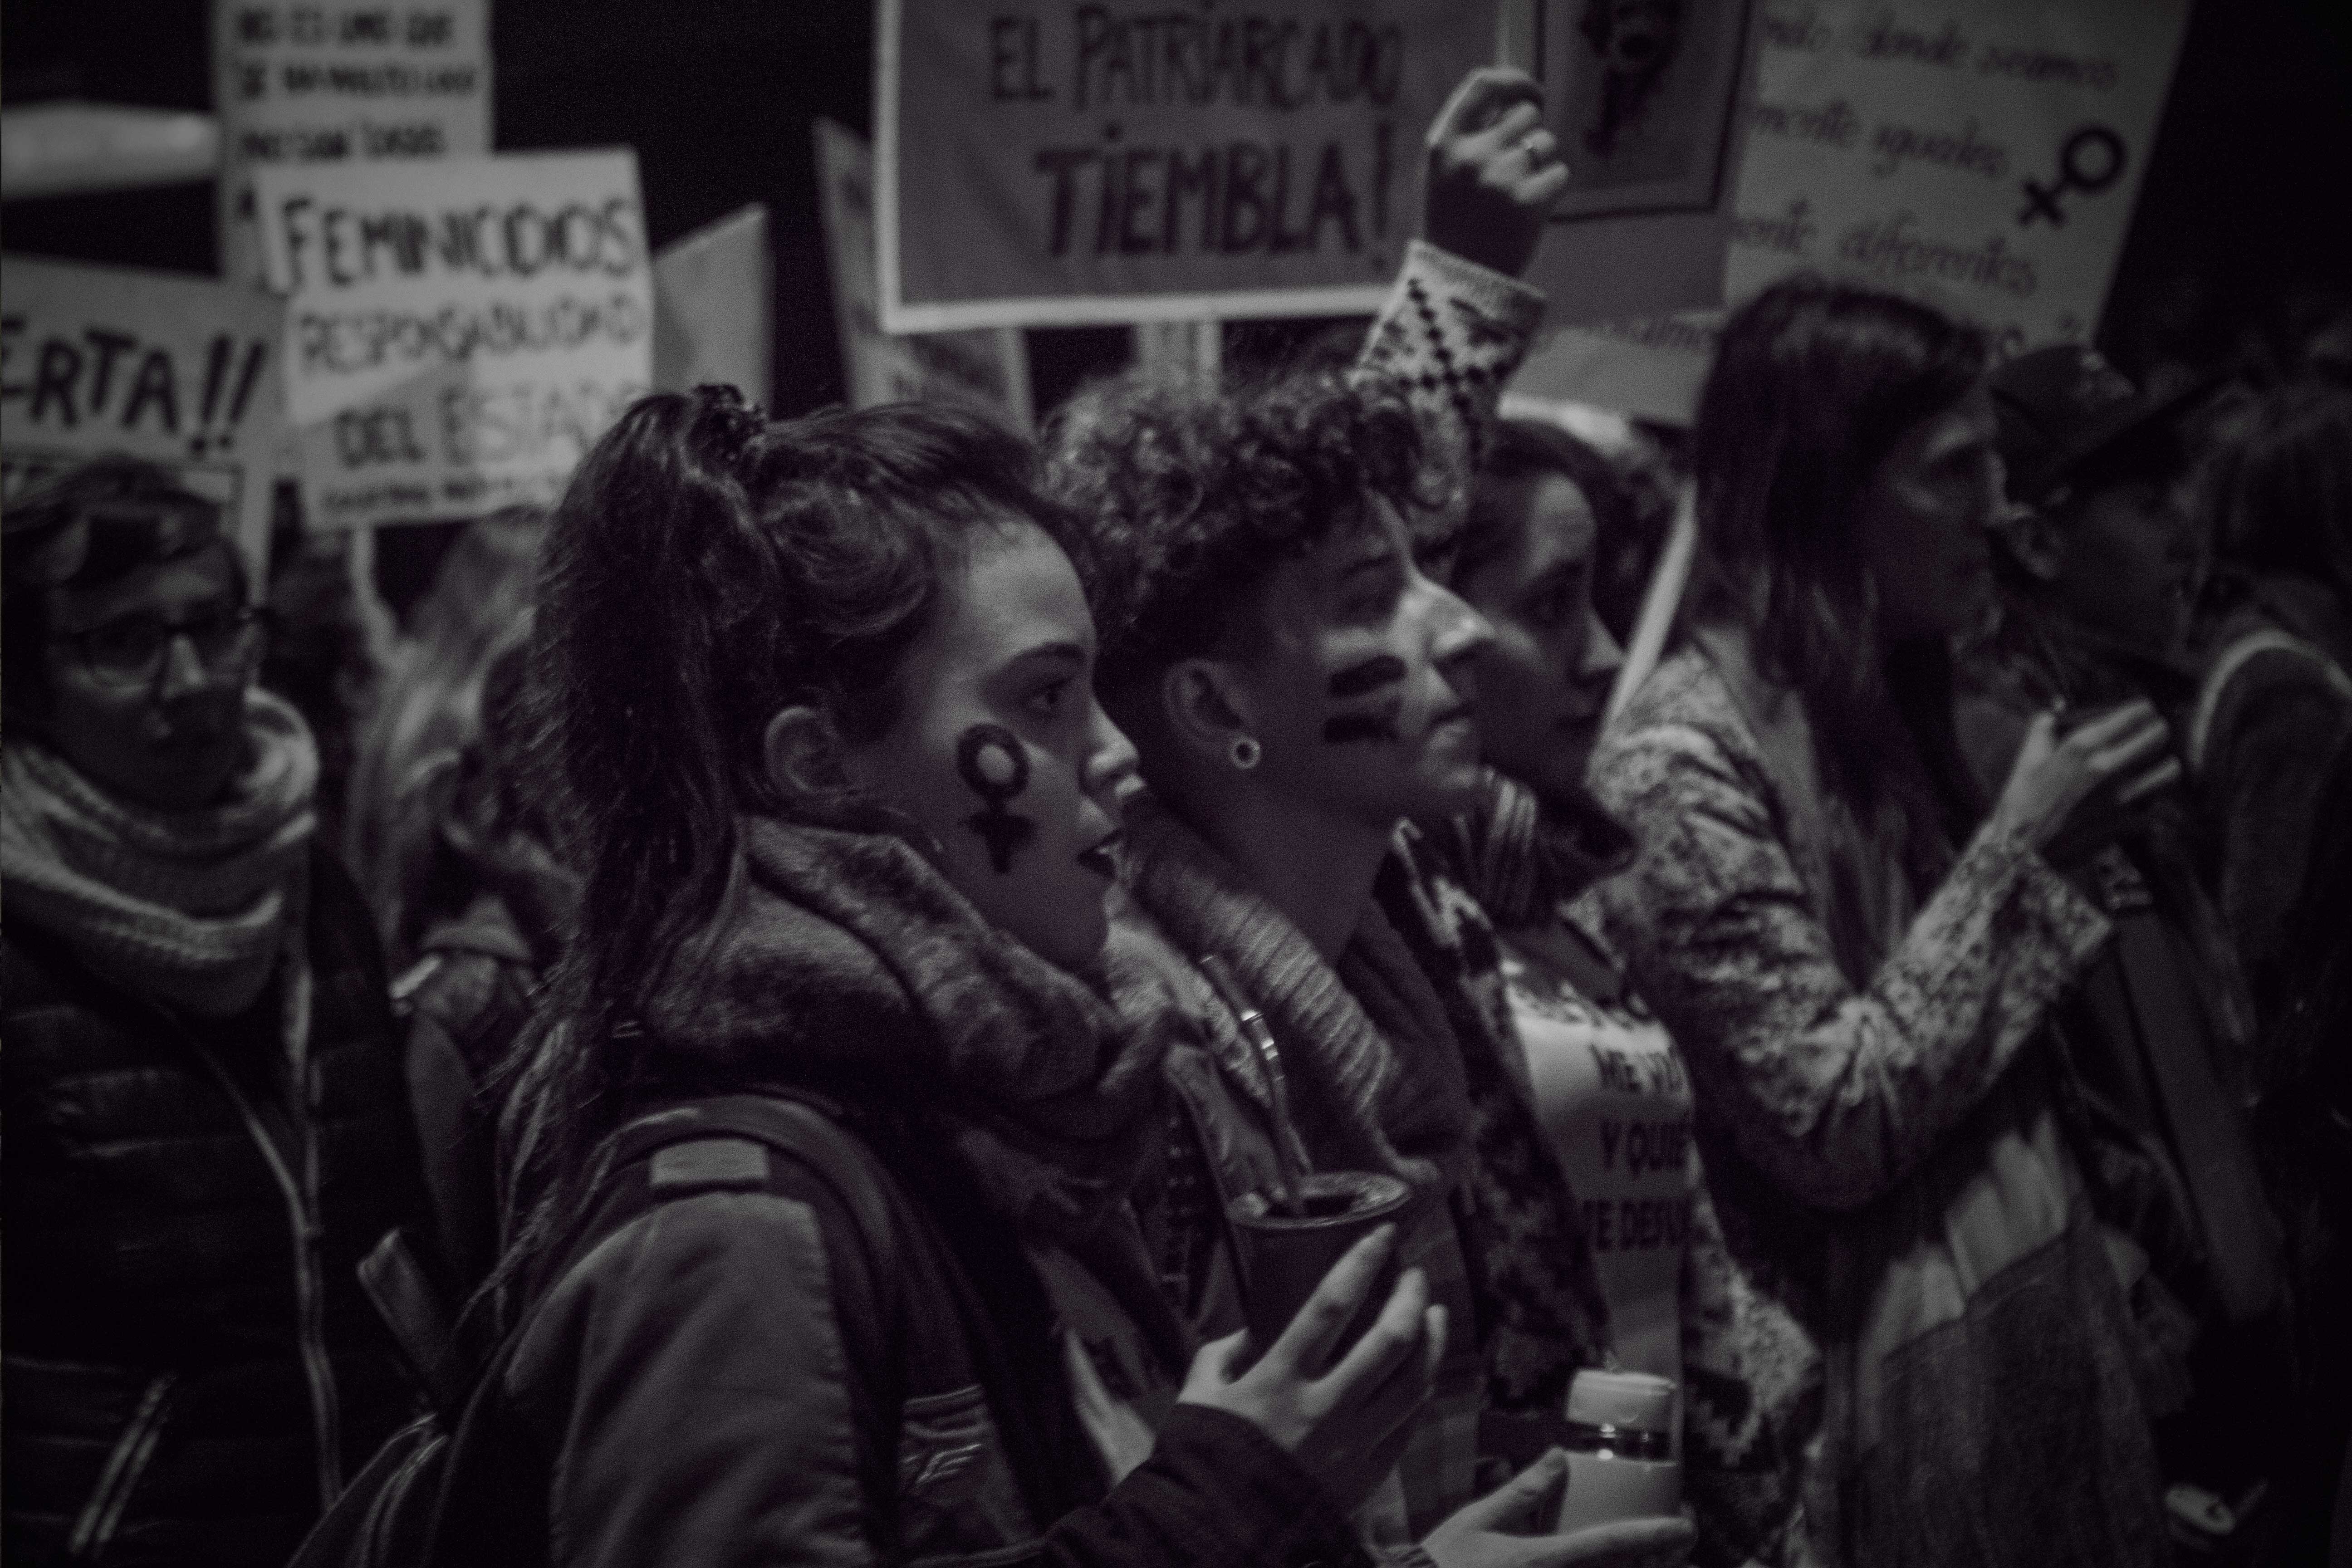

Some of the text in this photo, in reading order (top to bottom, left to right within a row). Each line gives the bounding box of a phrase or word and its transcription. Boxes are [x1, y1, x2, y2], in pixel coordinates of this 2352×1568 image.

[994, 1, 1402, 110] EL PATRIARCADO
[1870, 115, 2012, 180] iguales
[334, 406, 423, 468] DEL
